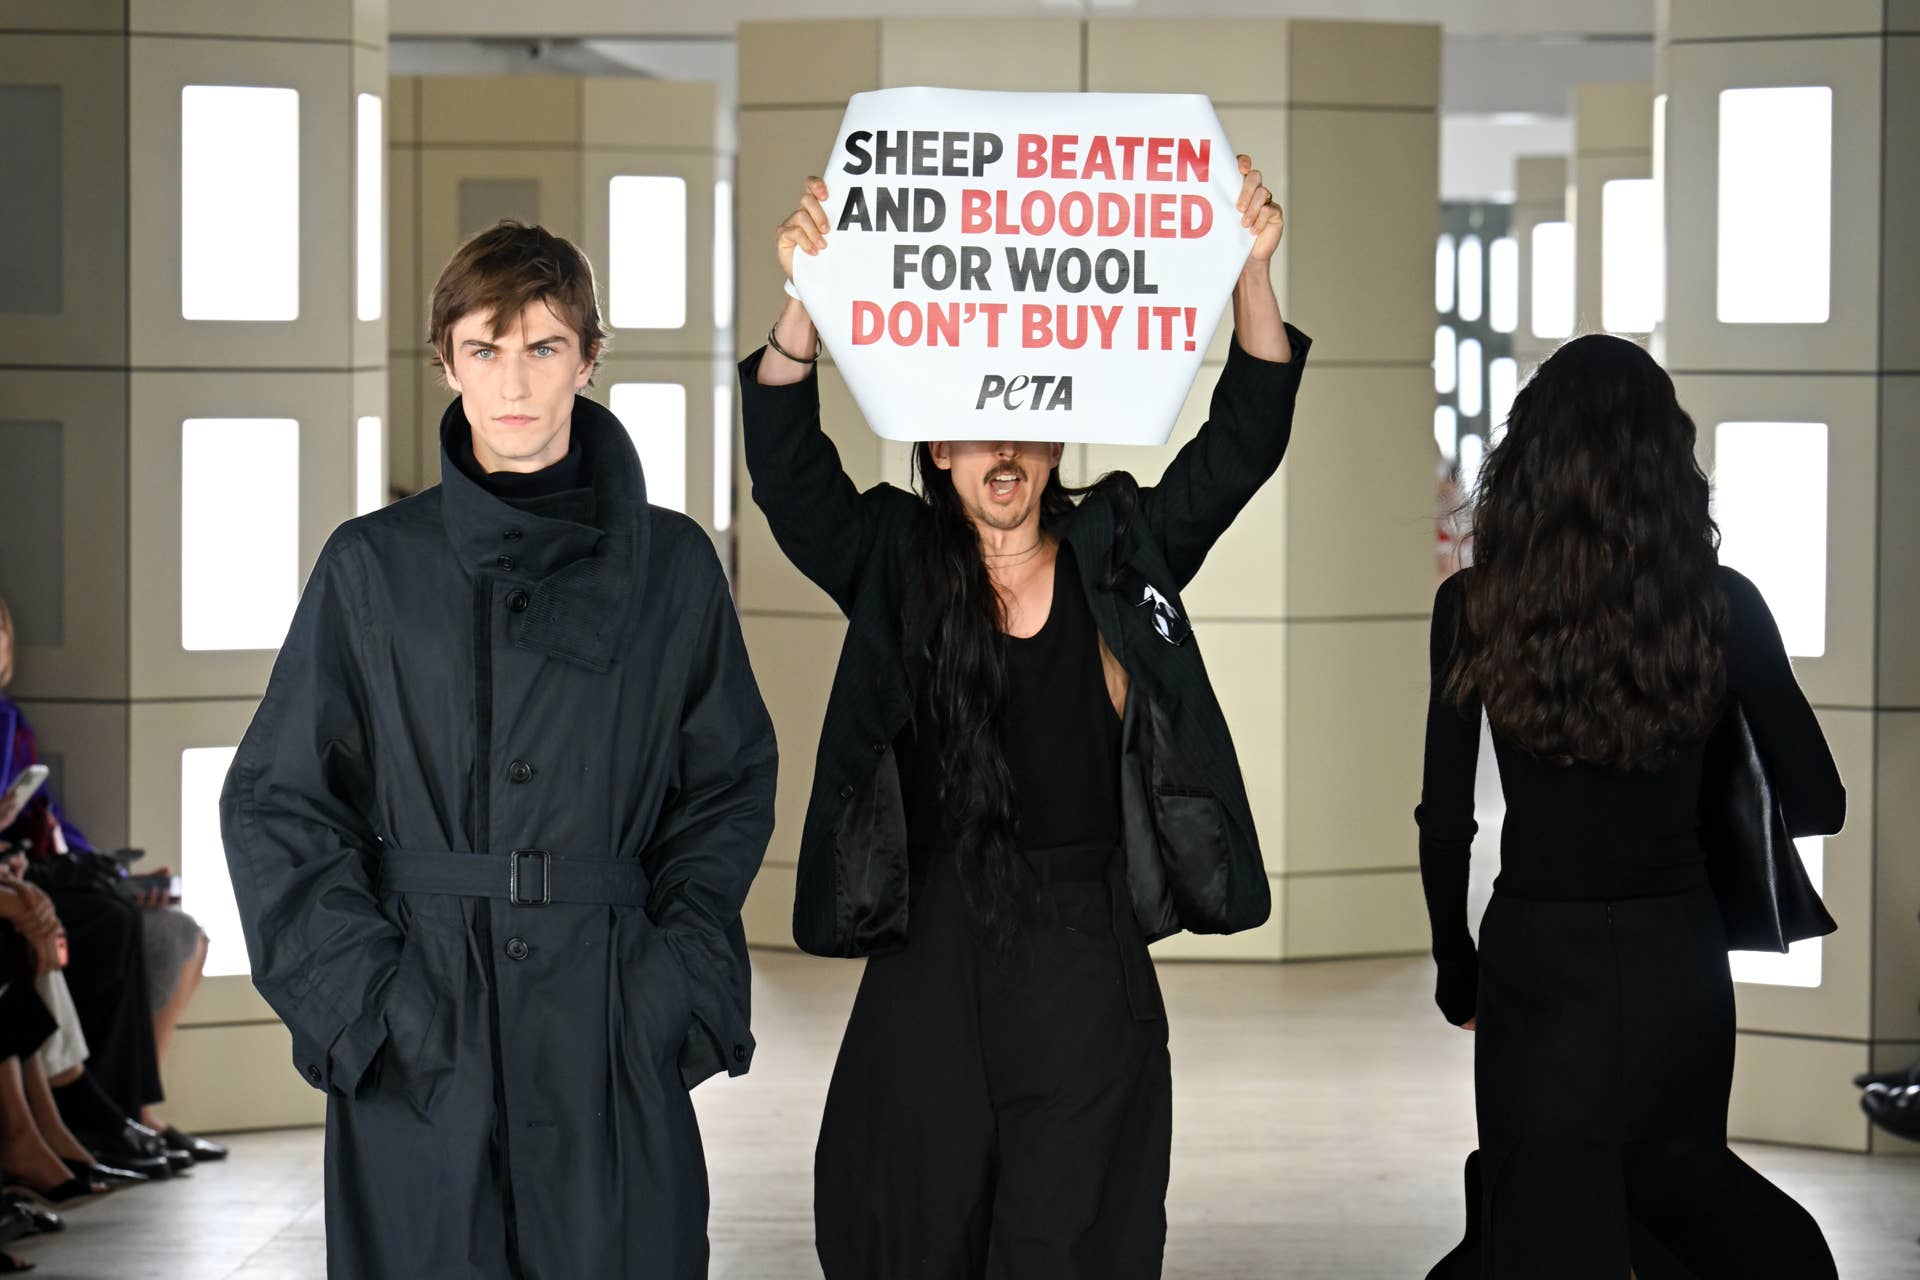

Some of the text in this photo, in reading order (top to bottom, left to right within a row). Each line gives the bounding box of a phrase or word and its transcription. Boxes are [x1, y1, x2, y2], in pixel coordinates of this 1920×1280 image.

[843, 130, 1211, 183] SHEEP BEATEN
[836, 186, 1214, 239] AND BLOODIED
[893, 244, 1159, 295] FOR WOOL
[851, 300, 1198, 352] DON’T BUY IT!
